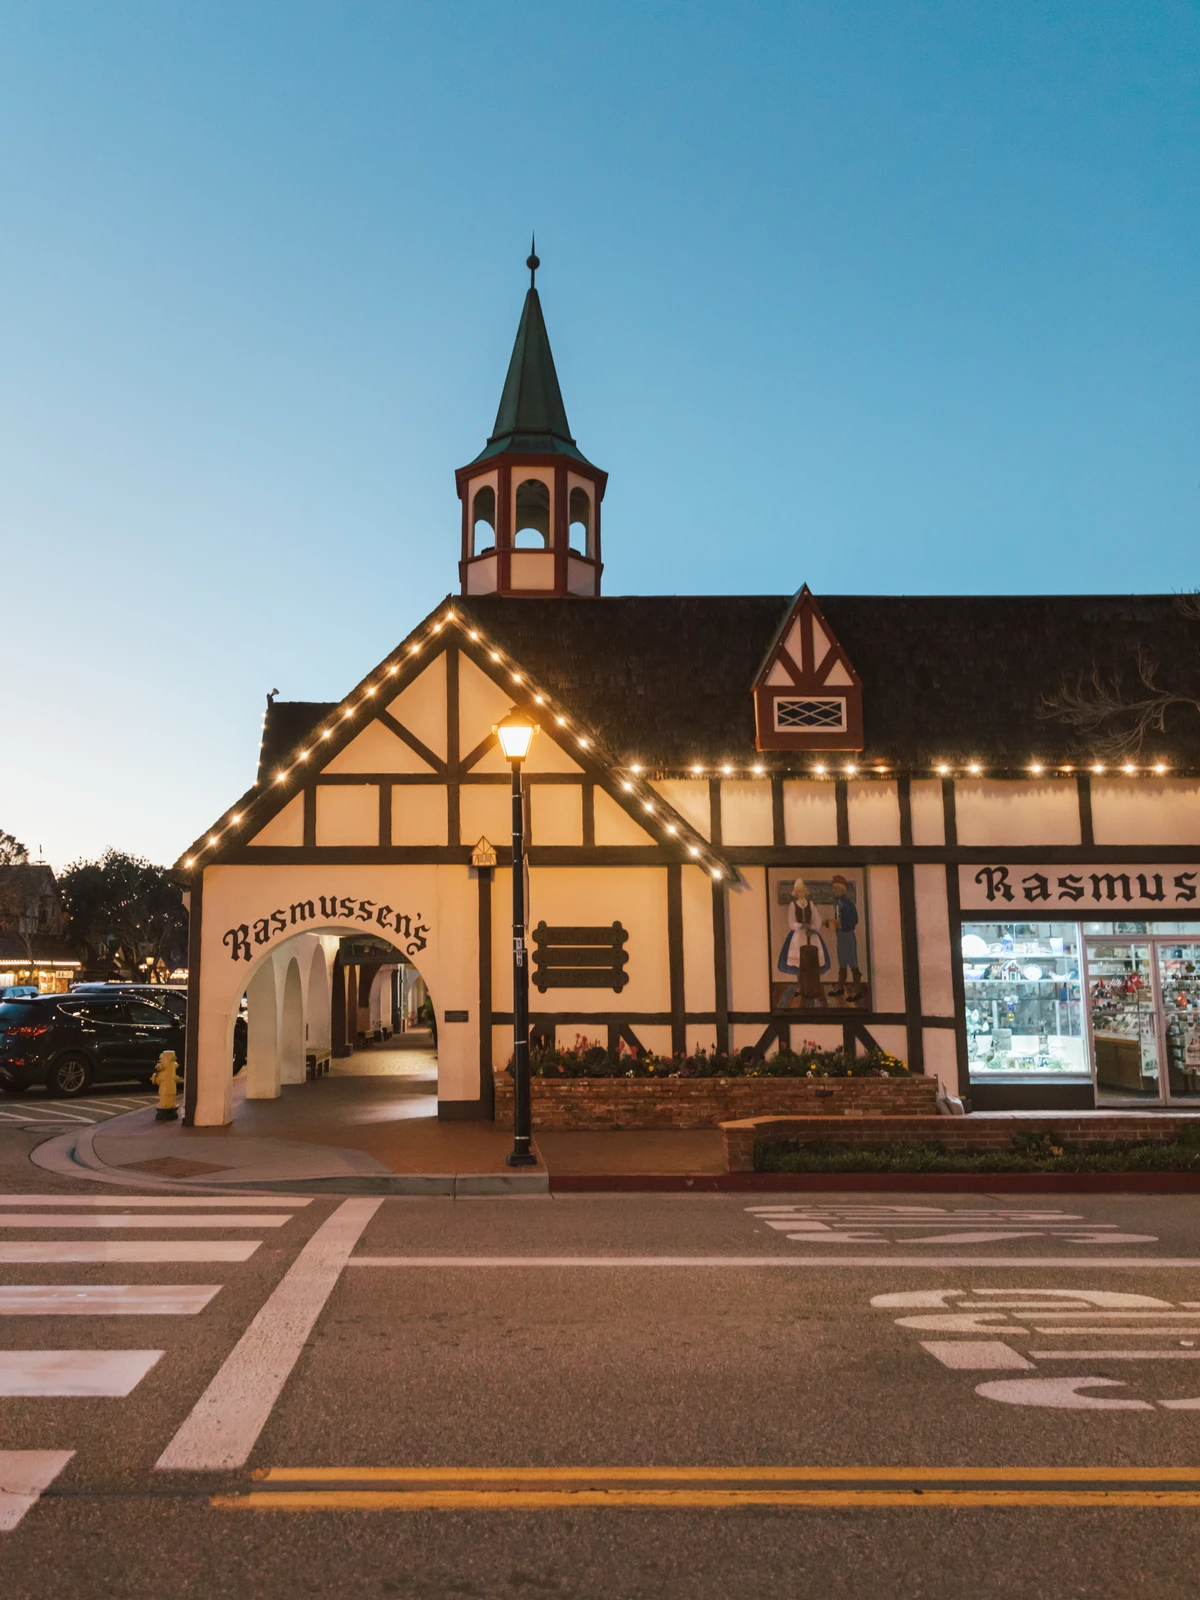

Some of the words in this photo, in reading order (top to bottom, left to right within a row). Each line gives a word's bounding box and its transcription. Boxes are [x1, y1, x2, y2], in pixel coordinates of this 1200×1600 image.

[975, 866, 1200, 902] Rasmus
[222, 895, 431, 962] Rasmussen's
[743, 1205, 1159, 1244] STOP
